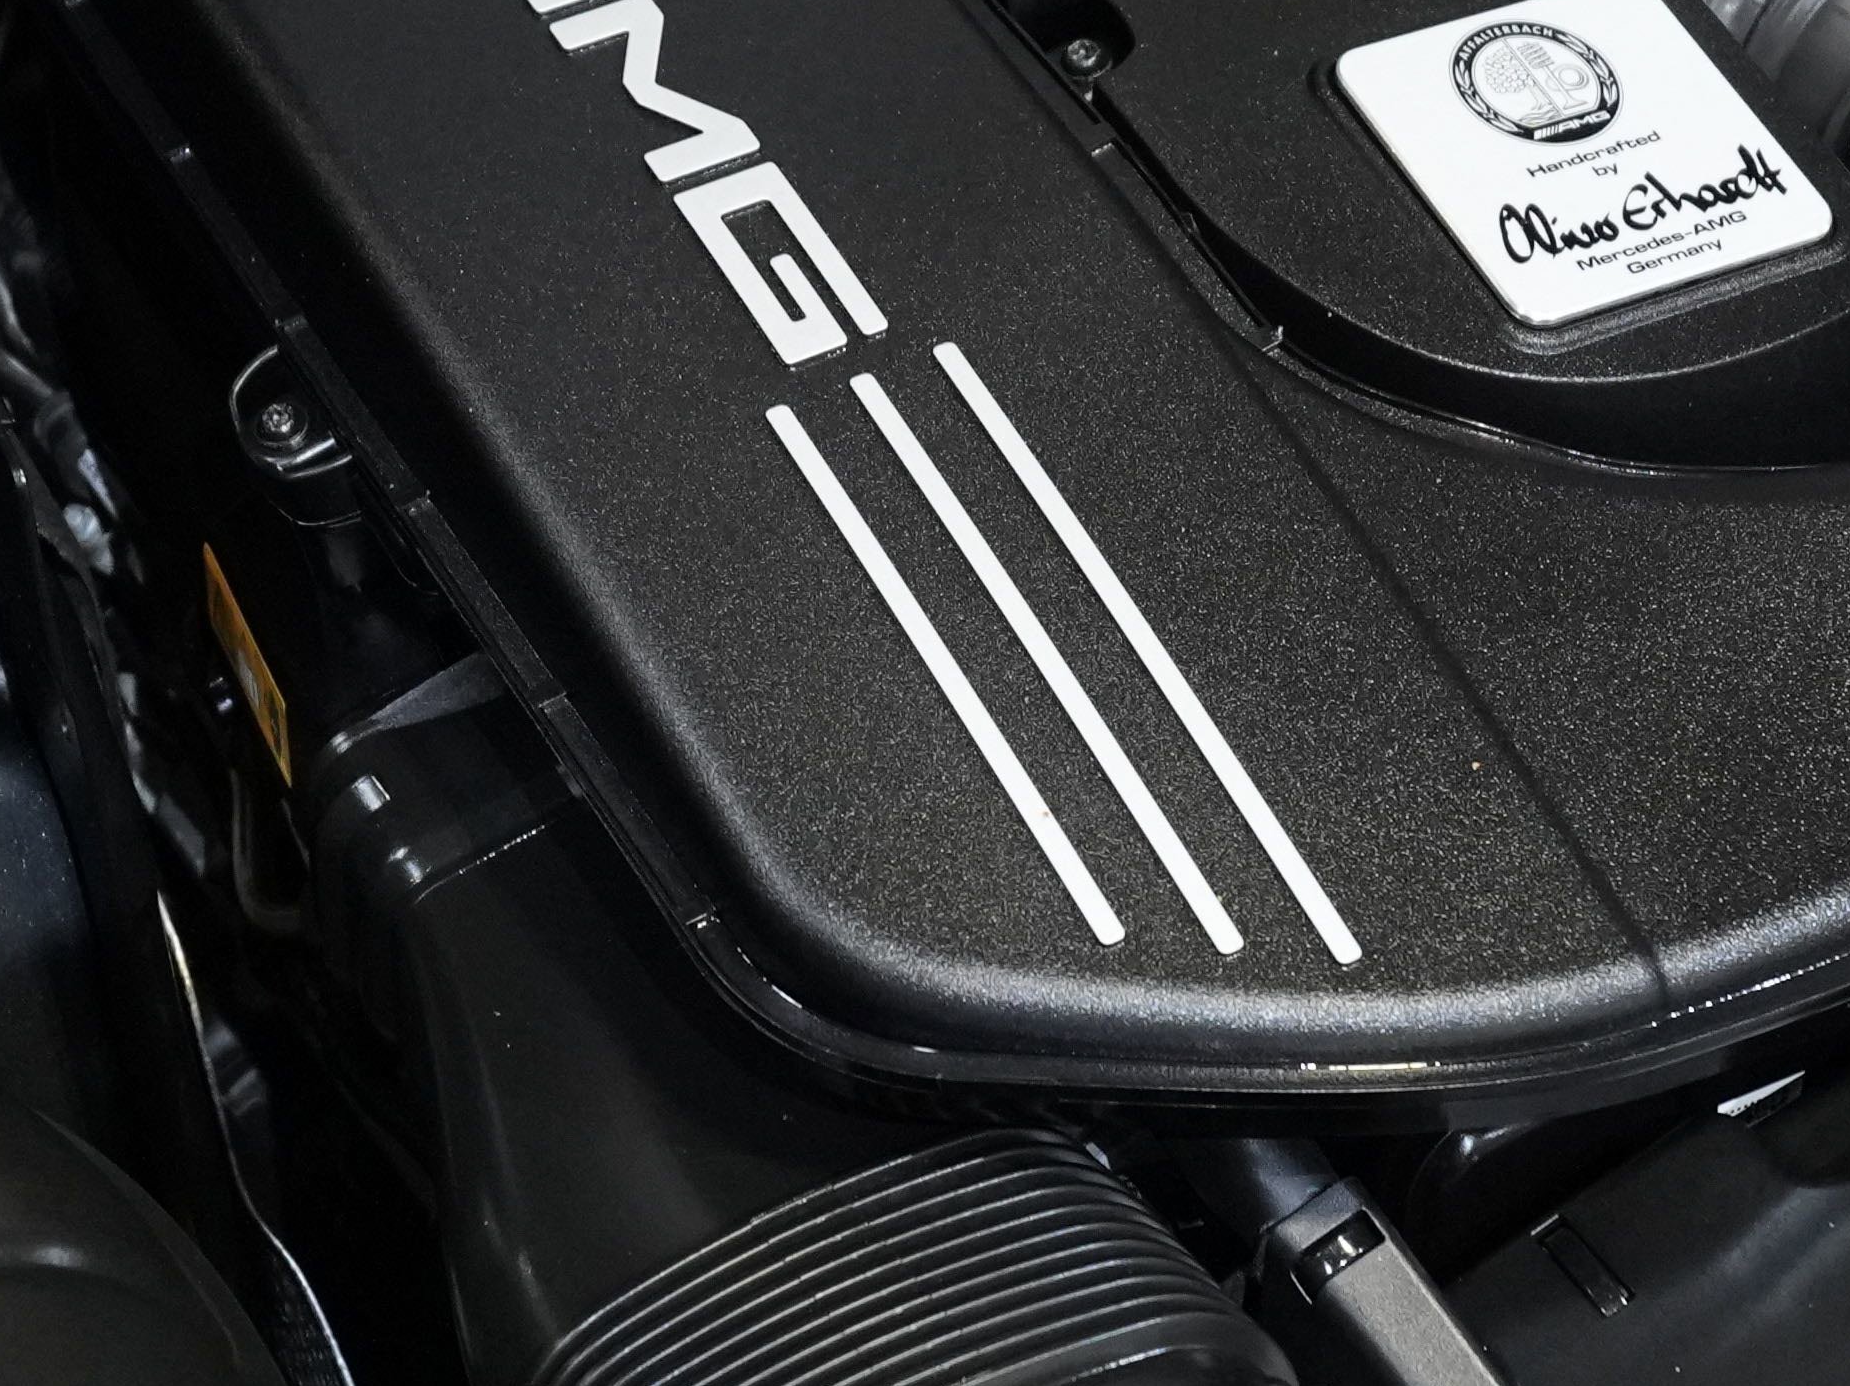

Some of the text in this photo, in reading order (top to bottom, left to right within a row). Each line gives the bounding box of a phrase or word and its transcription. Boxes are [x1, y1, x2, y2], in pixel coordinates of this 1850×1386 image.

[1458, 23, 1554, 62] AFFALTERBACH
[1559, 110, 1612, 134] AMG
[1526, 130, 1661, 178] Handcrafted
[1592, 163, 1619, 177] by
[1575, 210, 1748, 272] Mercedes-AMG
[1626, 238, 1723, 276] Germany
